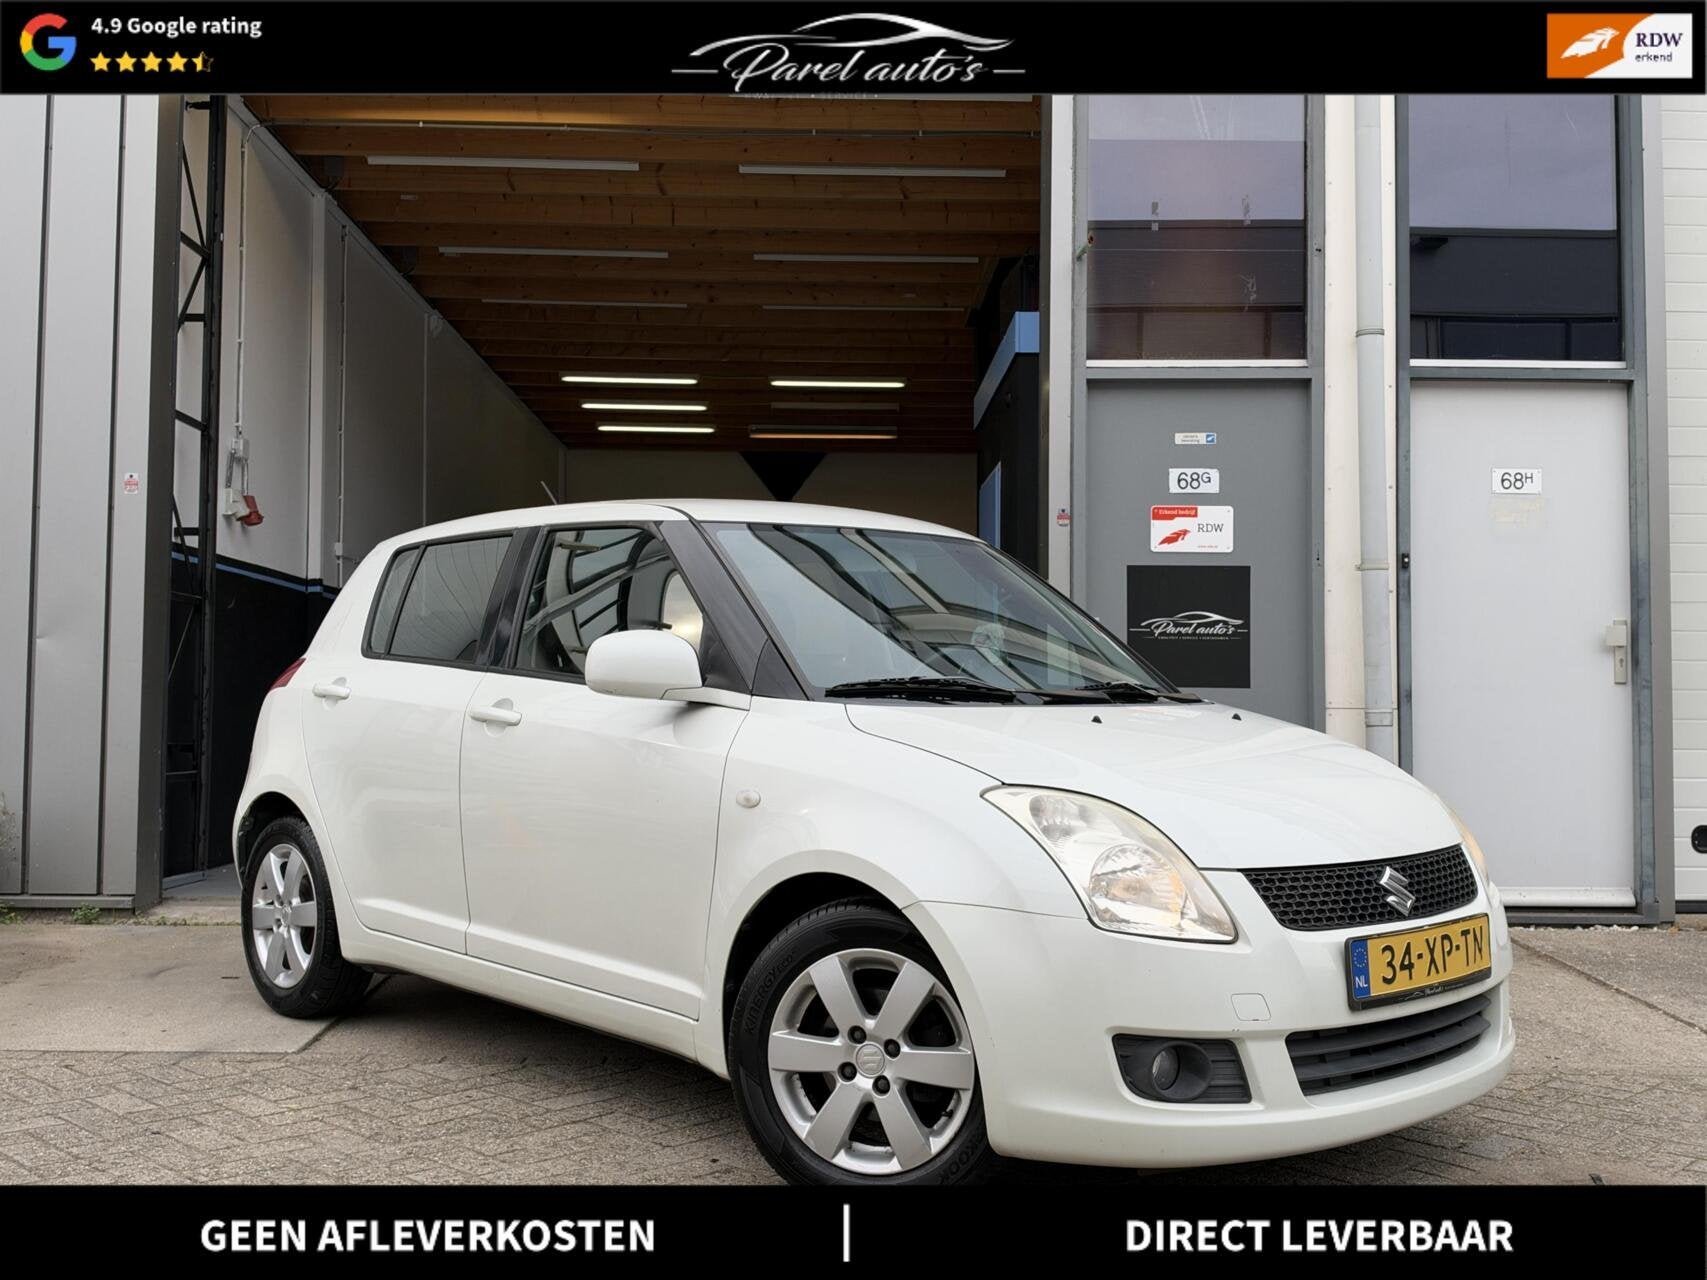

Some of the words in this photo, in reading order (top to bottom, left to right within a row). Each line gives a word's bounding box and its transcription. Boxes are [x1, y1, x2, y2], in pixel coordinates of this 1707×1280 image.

[1177, 472, 1211, 490] 68G
[1501, 472, 1533, 490] 68H
[1197, 523, 1224, 533] RDW
[1151, 620, 1198, 637] Parel
[1196, 622, 1236, 635] auto's
[1381, 925, 1483, 985] 34-XP-TN
[1354, 975, 1368, 989] NL
